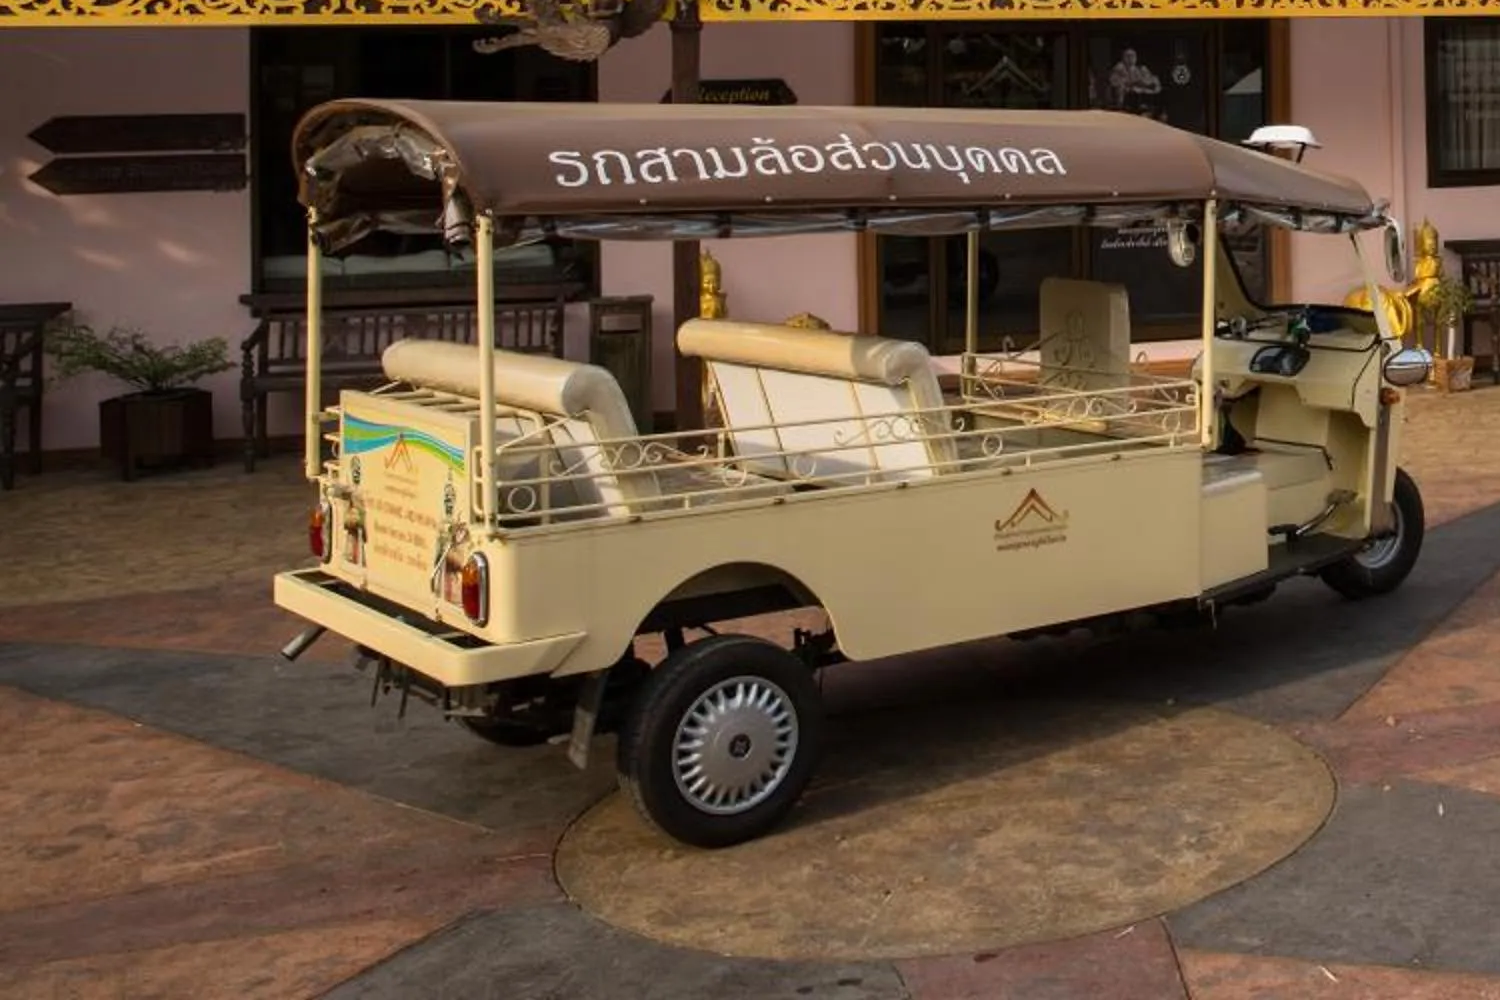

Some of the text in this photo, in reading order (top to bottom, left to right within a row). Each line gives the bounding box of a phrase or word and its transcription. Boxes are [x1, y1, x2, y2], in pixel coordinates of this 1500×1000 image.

[548, 133, 1067, 187] รถสามล้อส่วนบุคคล
